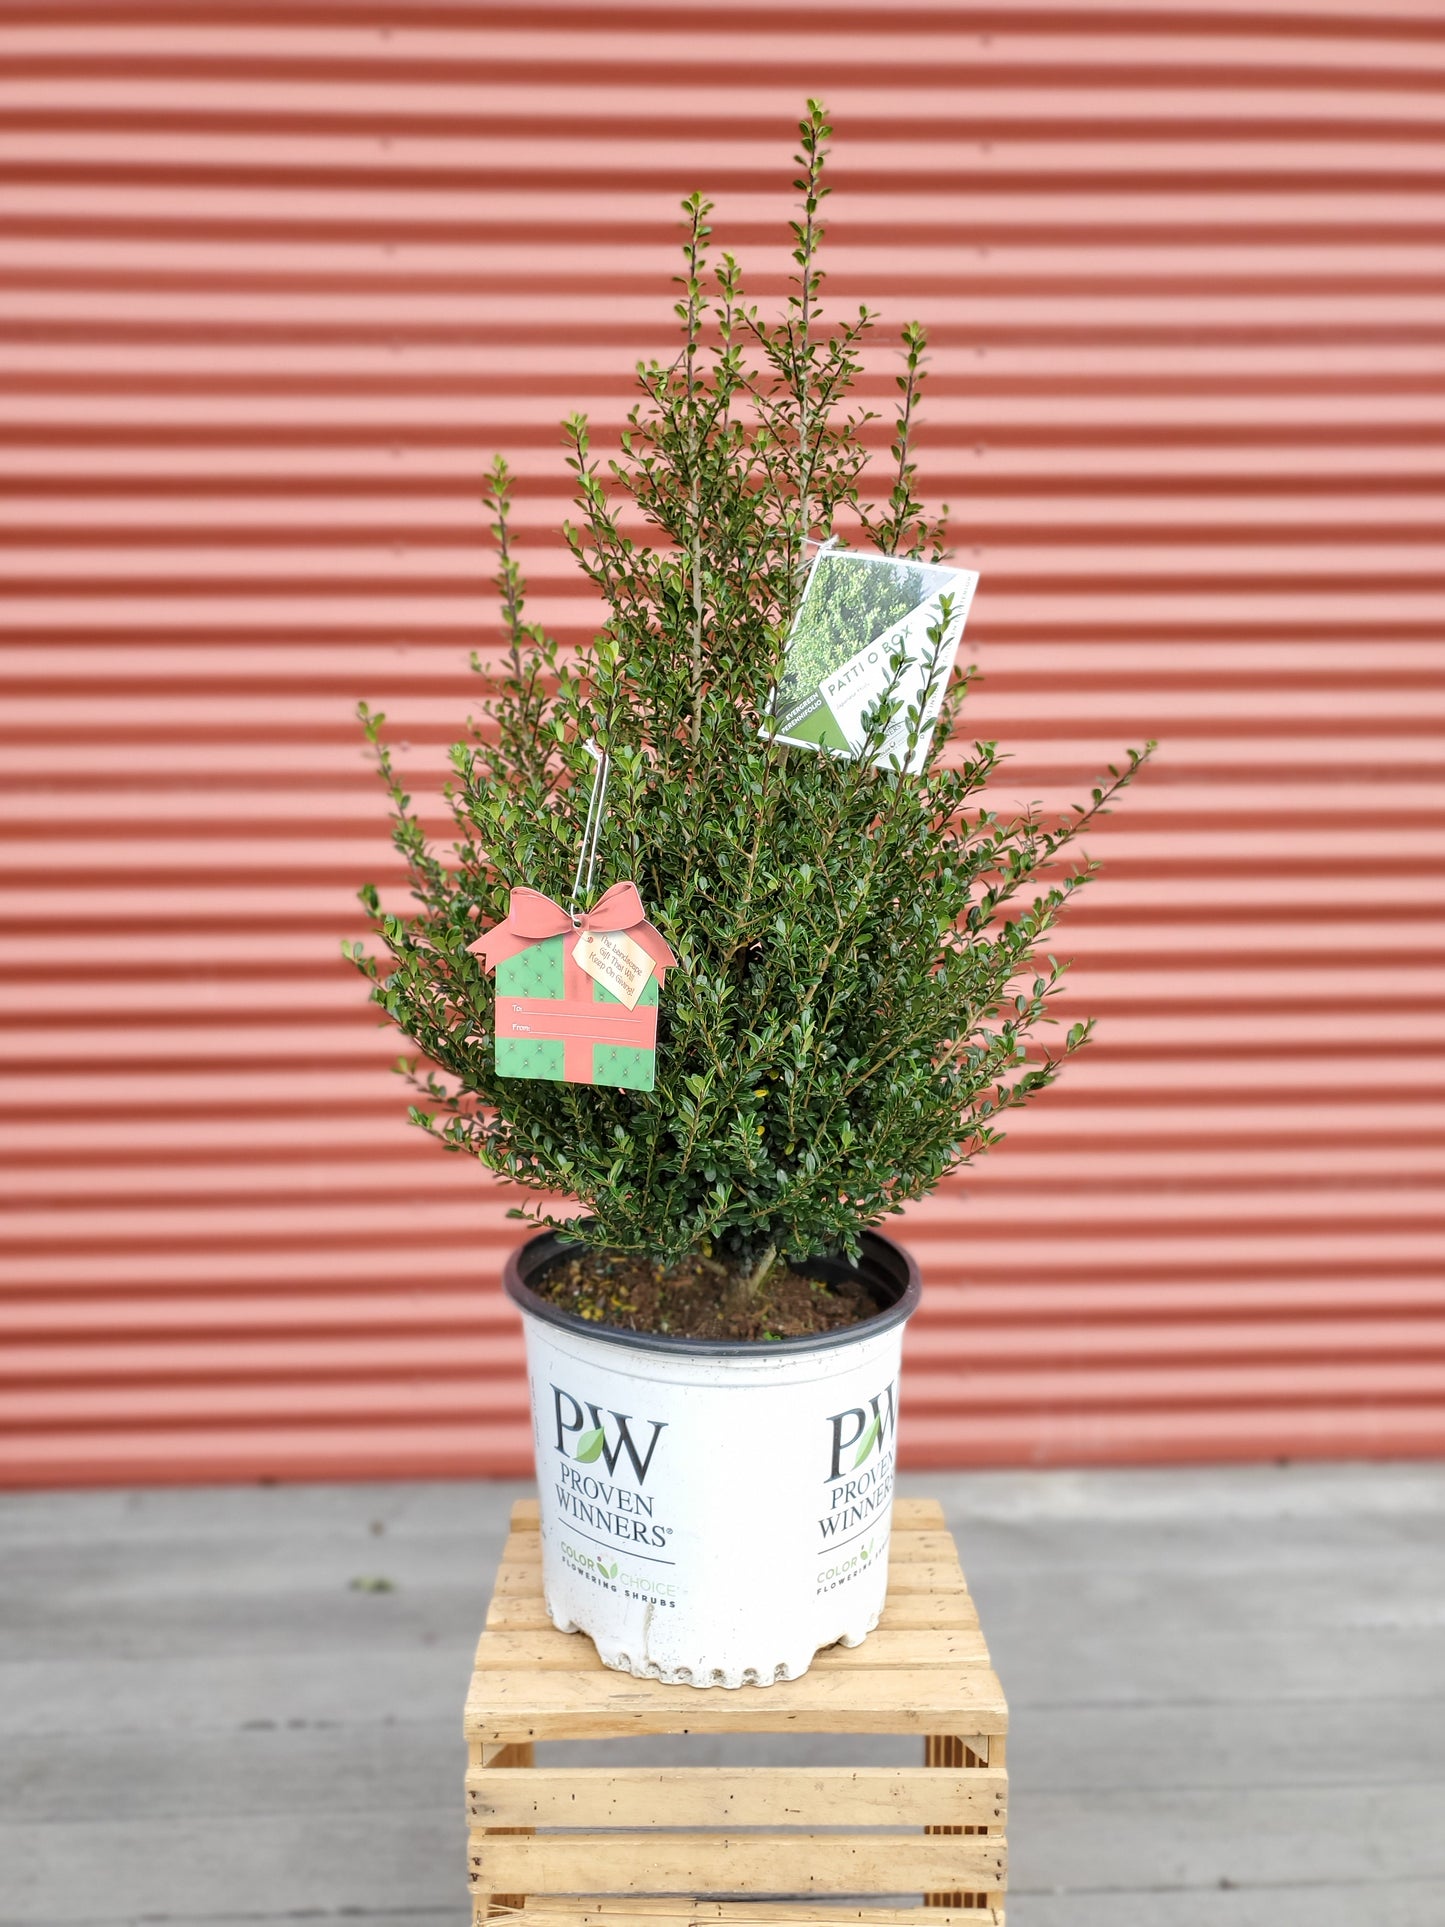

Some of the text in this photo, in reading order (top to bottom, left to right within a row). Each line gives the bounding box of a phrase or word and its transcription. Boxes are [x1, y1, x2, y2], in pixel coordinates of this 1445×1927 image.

[828, 662, 864, 696] PATTI
[882, 625, 912, 653] BOX
[781, 700, 822, 734] PERENNIFOLIO
[785, 692, 819, 720] EVERGREEN
[589, 951, 635, 997] Keep On Giving!
[600, 947, 635, 982] Gift That Will
[601, 935, 643, 976] The Landscape
[512, 1004, 523, 1012] To:
[512, 1023, 531, 1032] From:
[560, 1461, 655, 1518] PROVEN
[818, 1473, 894, 1538] WINNER
[561, 1541, 676, 1597] COLOR CHOICE
[561, 1556, 676, 1608] FLOWERING SHRUBS
[816, 1556, 858, 1584] COLOR
